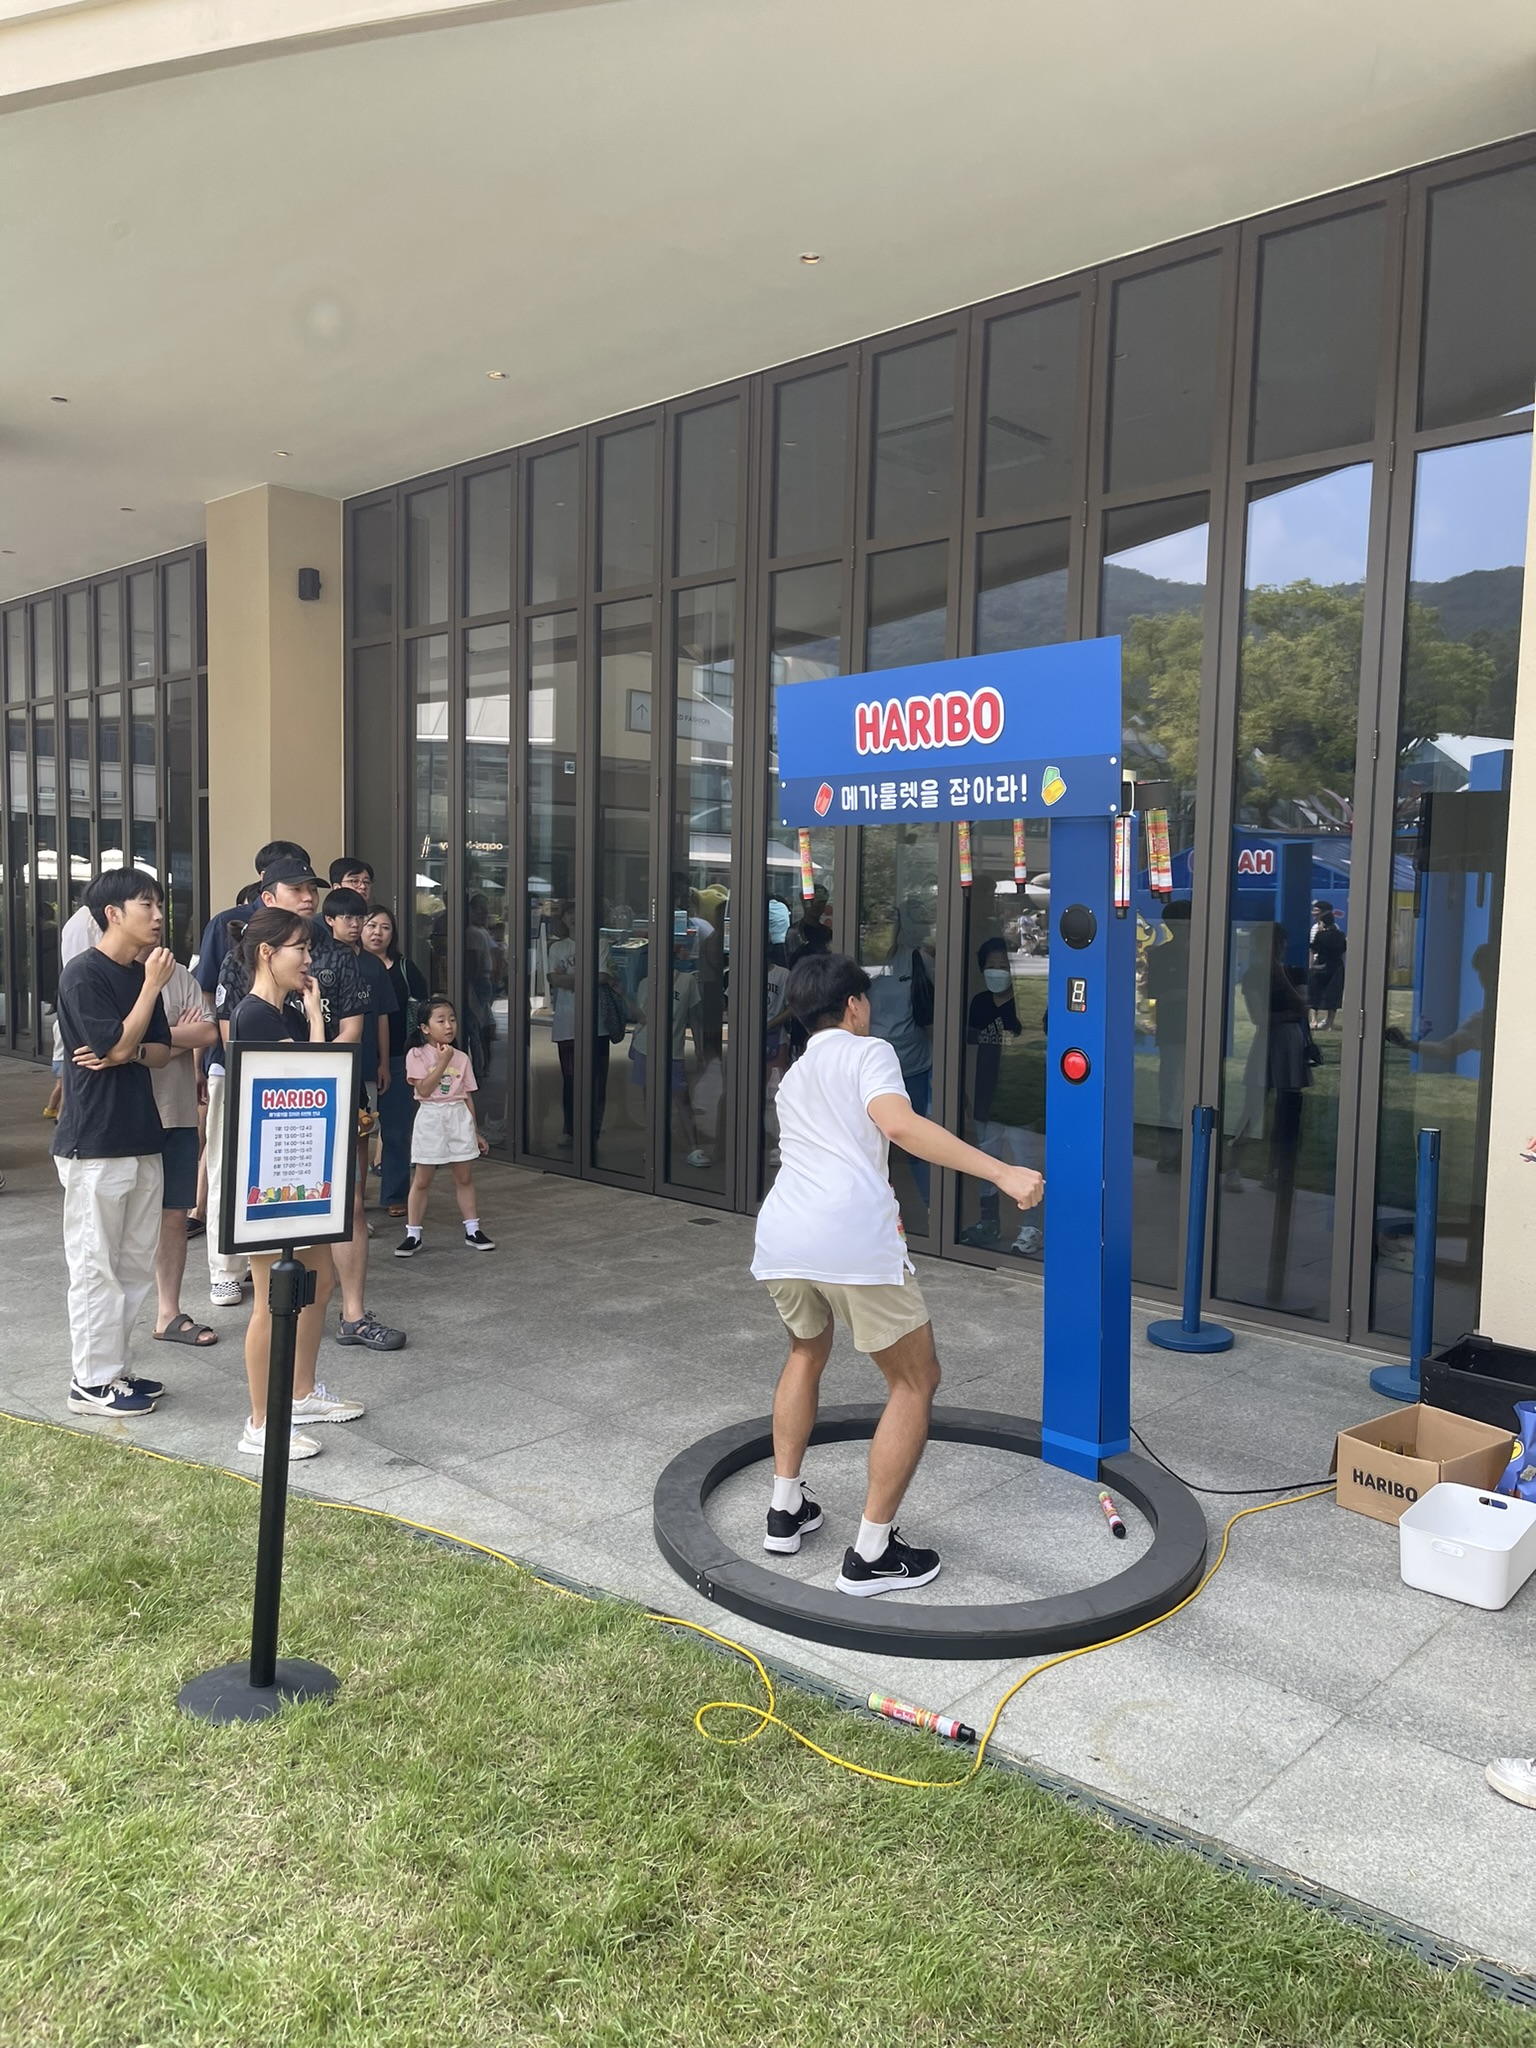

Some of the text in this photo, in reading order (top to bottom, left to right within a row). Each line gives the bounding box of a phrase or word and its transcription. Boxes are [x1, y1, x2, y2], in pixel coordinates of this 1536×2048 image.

[857, 688, 1003, 754] HARIBO
[841, 773, 1028, 811] 메가룰렛을 잡아라!
[262, 1089, 327, 1109] HARIBO
[1353, 1467, 1418, 1503] HARIBO
